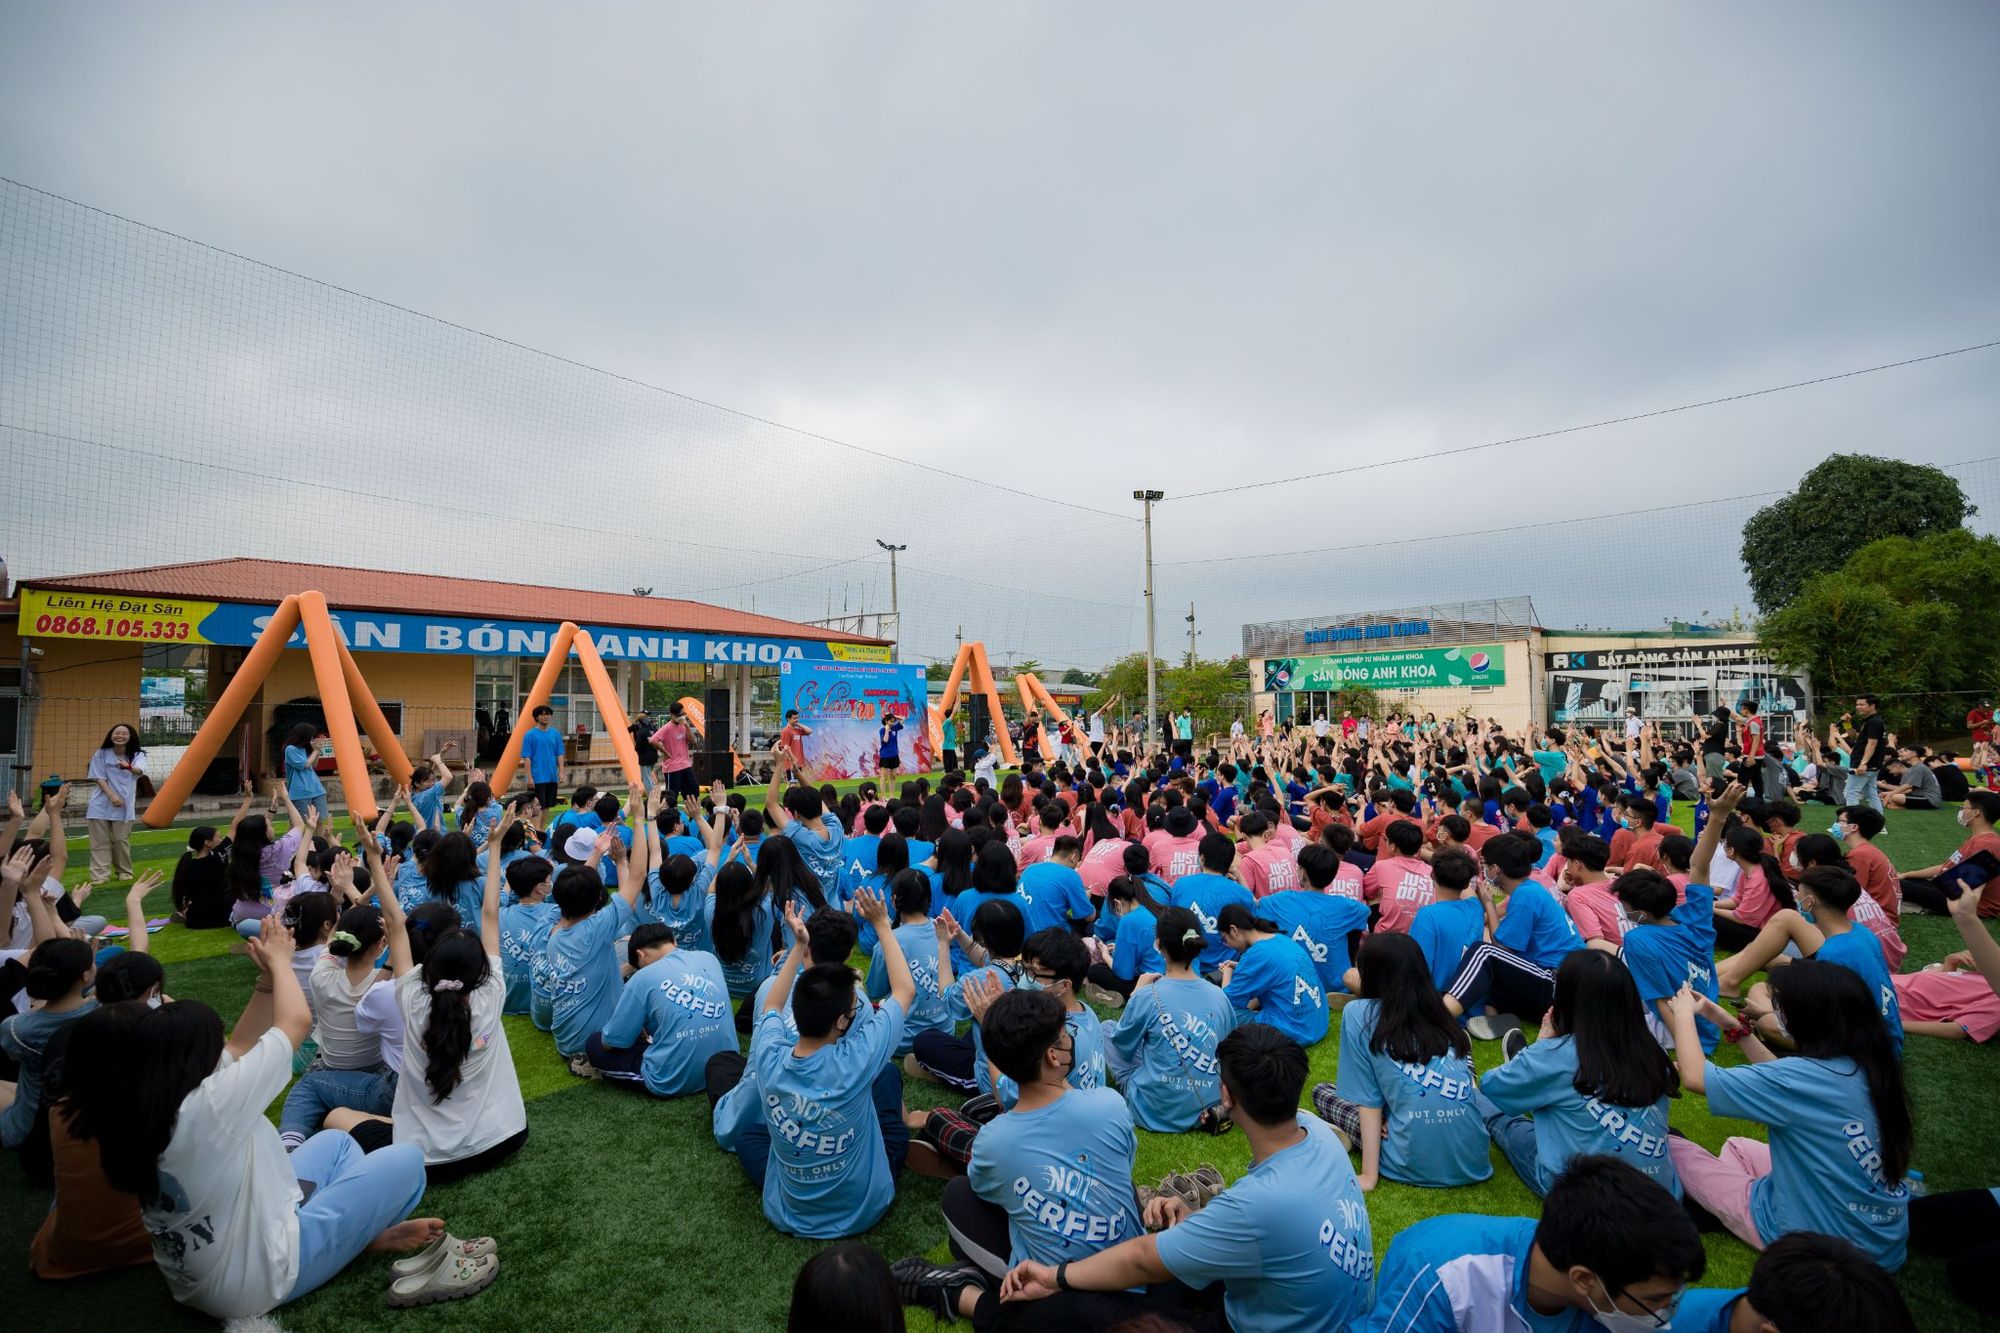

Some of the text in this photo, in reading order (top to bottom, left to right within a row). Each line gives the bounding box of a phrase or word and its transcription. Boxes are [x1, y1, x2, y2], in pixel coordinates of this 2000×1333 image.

[46, 596, 183, 615] Liên Hệ Đặt Sân
[35, 614, 190, 640] 0868.105.333
[1365, 624, 1390, 638] ANH
[1392, 621, 1429, 637] KHOA
[426, 623, 580, 654] BÓN
[597, 634, 689, 659] ANH
[704, 641, 804, 663] KHOA
[1322, 657, 1342, 665] DOANH
[1343, 656, 1364, 664] NGHIỆP
[1373, 654, 1390, 662] NHÂN
[1598, 650, 1623, 666] BẤT
[1707, 649, 1740, 660] ANH
[1312, 664, 1437, 682] SÂN BÓNG ANH KHOA
[1171, 851, 1199, 864] JUST
[1170, 864, 1197, 876] DO IT
[1269, 860, 1293, 876] JUST
[1269, 875, 1293, 891] DO IT
[1328, 879, 1360, 895] JUST
[1396, 872, 1434, 892] JUST
[1396, 886, 1433, 906] DO IT
[682, 972, 717, 996] NOT
[660, 979, 726, 1019] PERFECT
[676, 1023, 720, 1039] BUT ONLY
[1159, 1012, 1220, 1075] PERFEC
[1161, 1075, 1213, 1088] BUT ONLY
[1408, 1108, 1466, 1119] BUT ONLY
[766, 1094, 856, 1156] PERFECT
[784, 1160, 846, 1175] BUT ONLY
[1046, 1165, 1104, 1204] NOT
[1013, 1176, 1127, 1242] PERFECT
[1849, 1202, 1879, 1213] BUT
